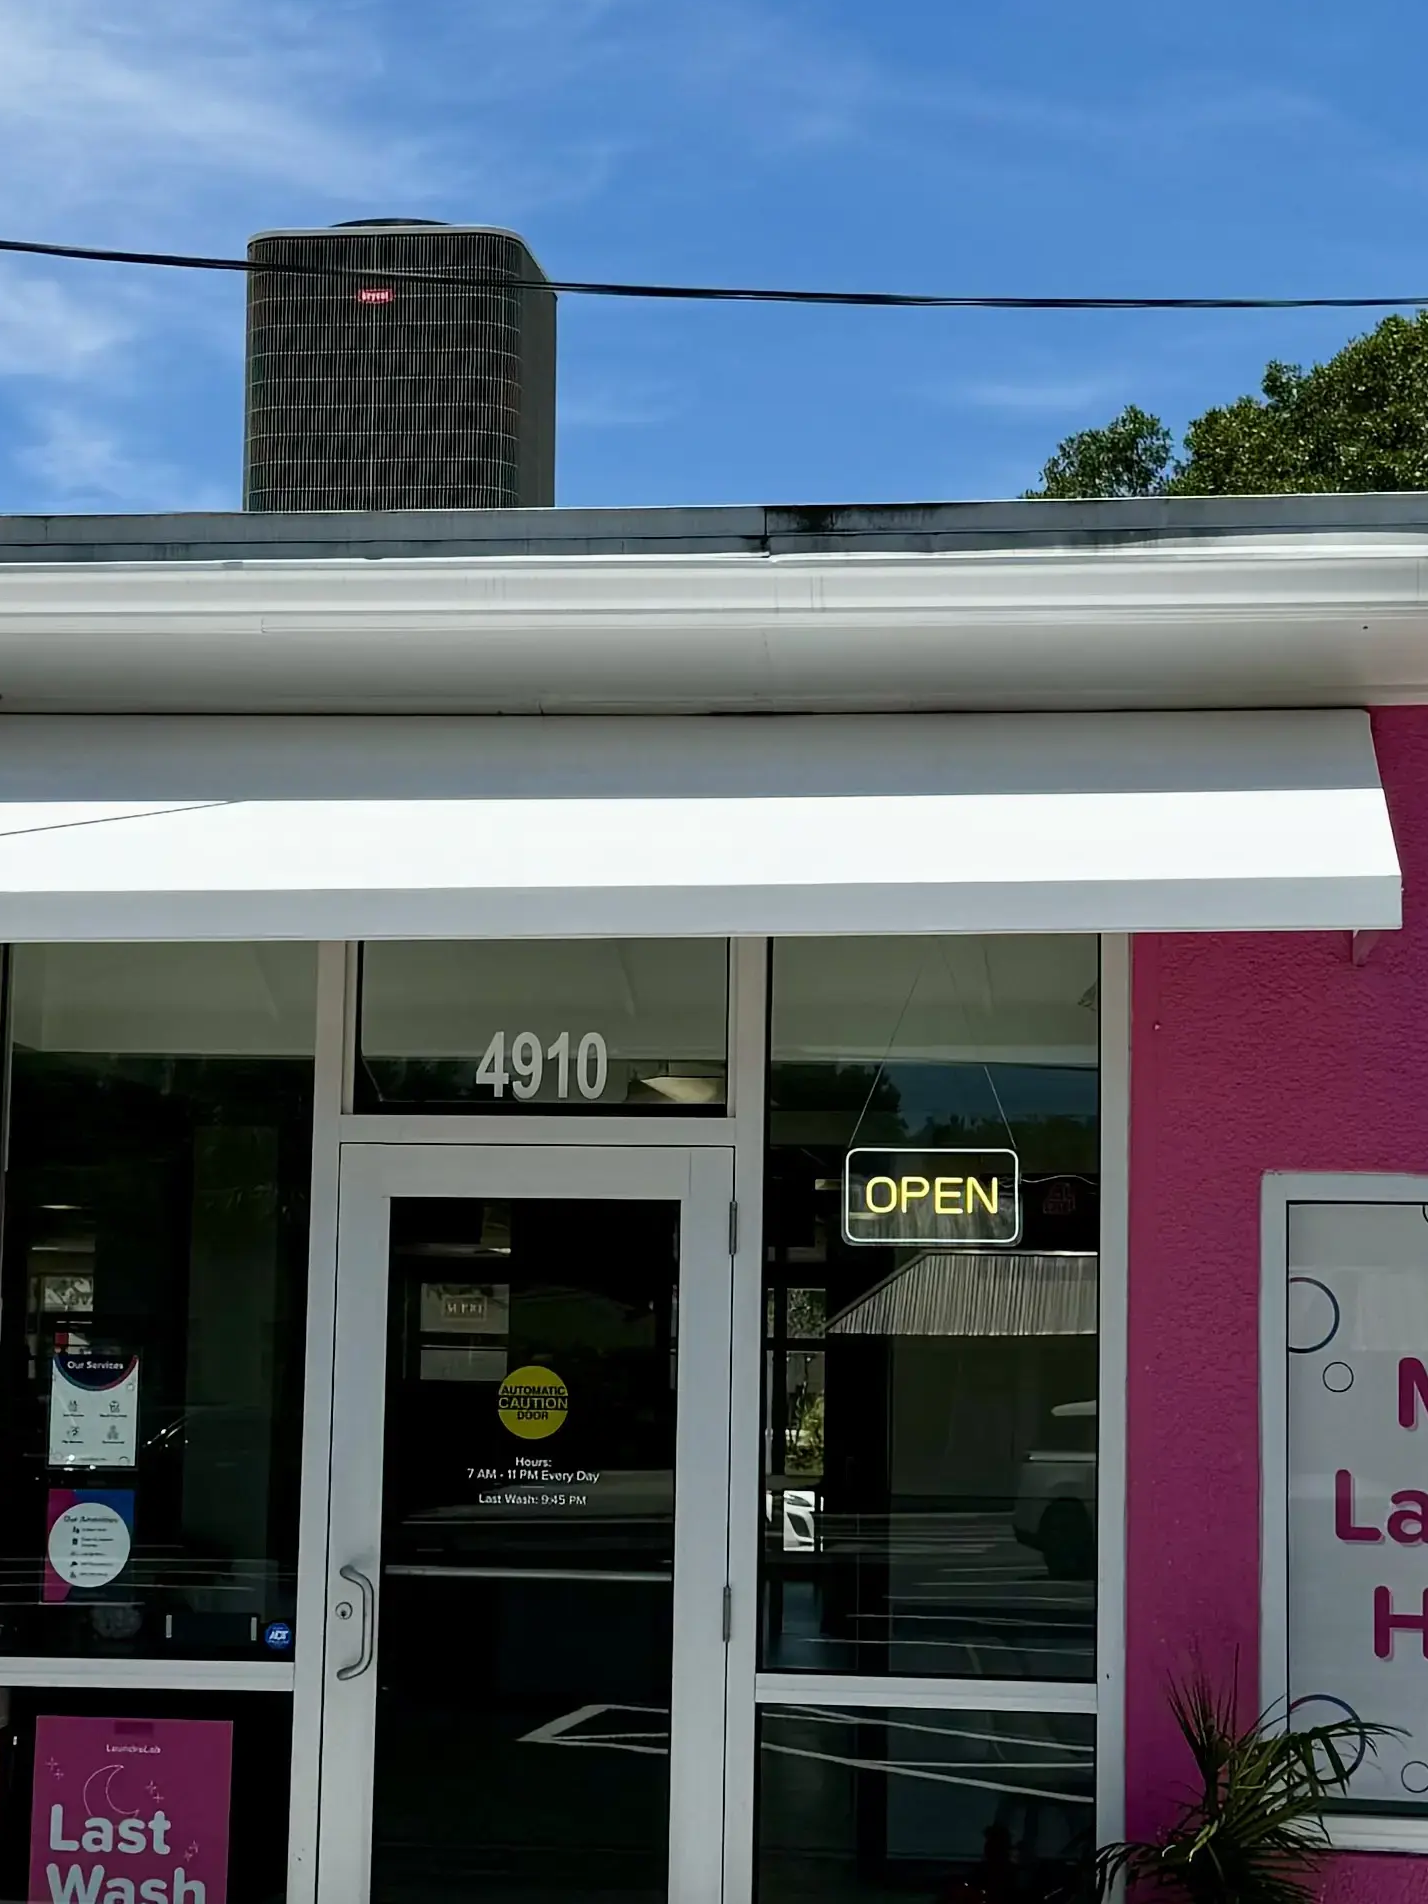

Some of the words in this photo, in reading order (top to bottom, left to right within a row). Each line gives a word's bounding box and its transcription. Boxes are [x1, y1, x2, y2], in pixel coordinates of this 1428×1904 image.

[475, 1031, 608, 1100] 4910
[865, 1176, 999, 1214] OPEN
[501, 1385, 566, 1395] AUTOMATIC
[498, 1397, 568, 1409] CAUTION
[516, 1410, 549, 1420] DOOR
[515, 1456, 552, 1468] Hours:
[467, 1468, 474, 1479] 7
[477, 1469, 497, 1479] AM
[507, 1469, 517, 1479] 11
[519, 1470, 538, 1480] PM
[541, 1470, 574, 1483] Every
[576, 1471, 600, 1484] Day
[478, 1493, 502, 1504] Last
[505, 1494, 538, 1504] Wash:
[541, 1494, 565, 1505] 9:45
[569, 1495, 586, 1505] PM
[50, 1803, 172, 1856] Last
